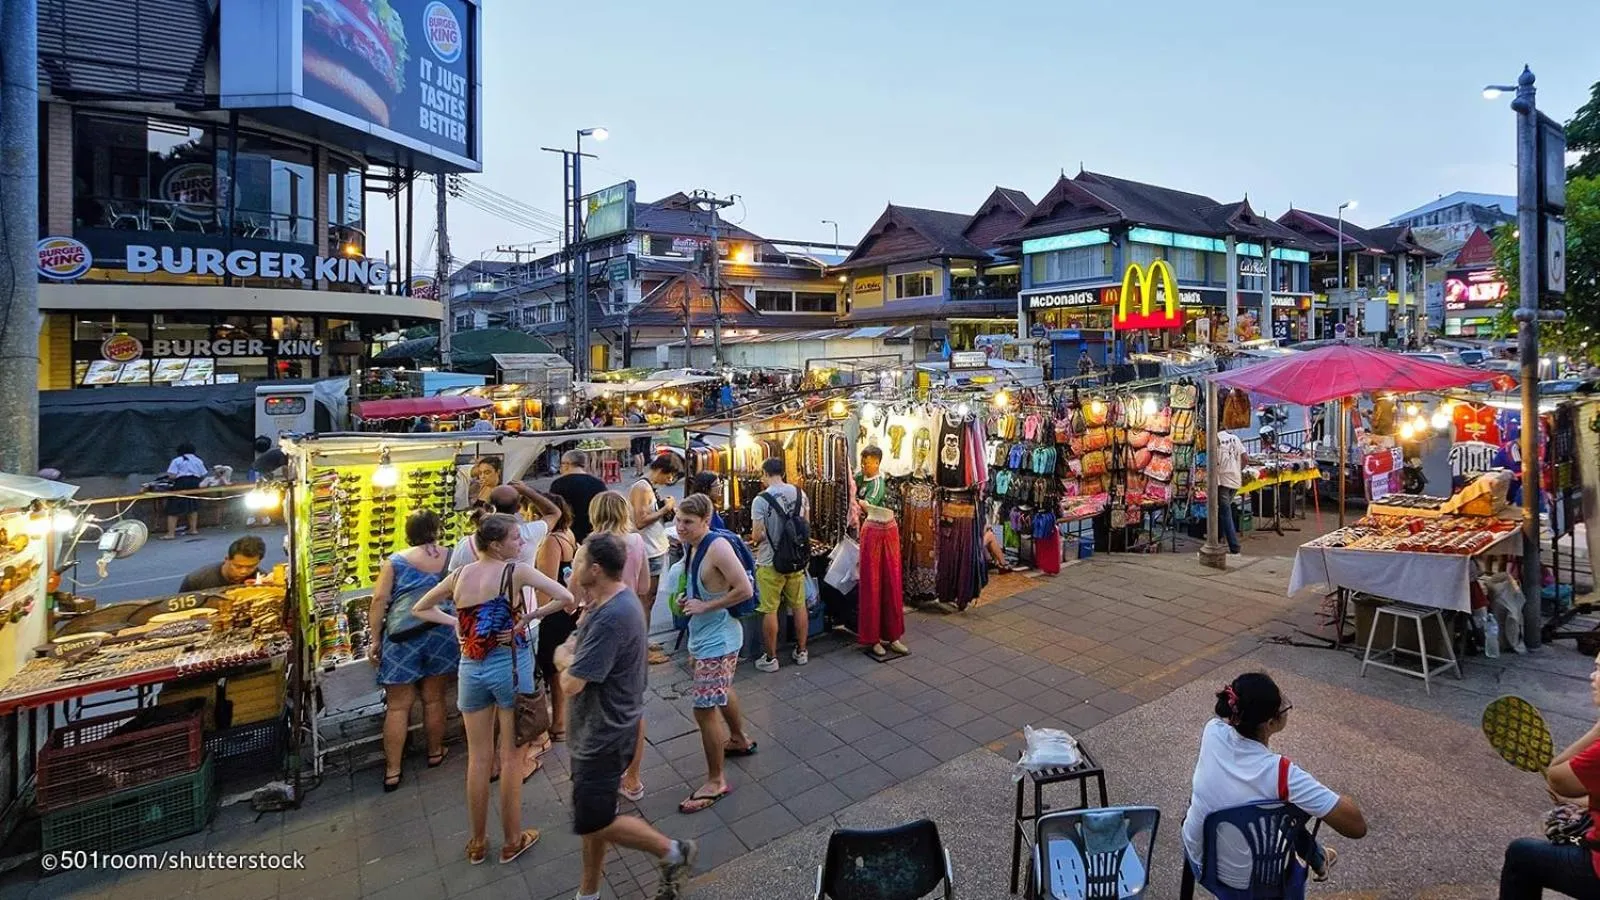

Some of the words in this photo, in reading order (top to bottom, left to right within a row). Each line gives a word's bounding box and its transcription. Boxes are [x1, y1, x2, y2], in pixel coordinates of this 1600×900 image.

[428, 17, 457, 31] BURGER
[431, 29, 457, 44] KING
[420, 56, 432, 82] IT
[436, 66, 466, 98] JUST
[420, 82, 466, 121] TASTES
[420, 106, 467, 145] BETTER
[39, 246, 84, 258] BURGER
[41, 253, 85, 269] KING
[126, 245, 306, 280] BURGER
[315, 255, 389, 287] KING
[1030, 291, 1094, 308] McDonald's
[153, 338, 264, 356] BURGER
[277, 339, 323, 356] KING
[168, 594, 197, 612] 515
